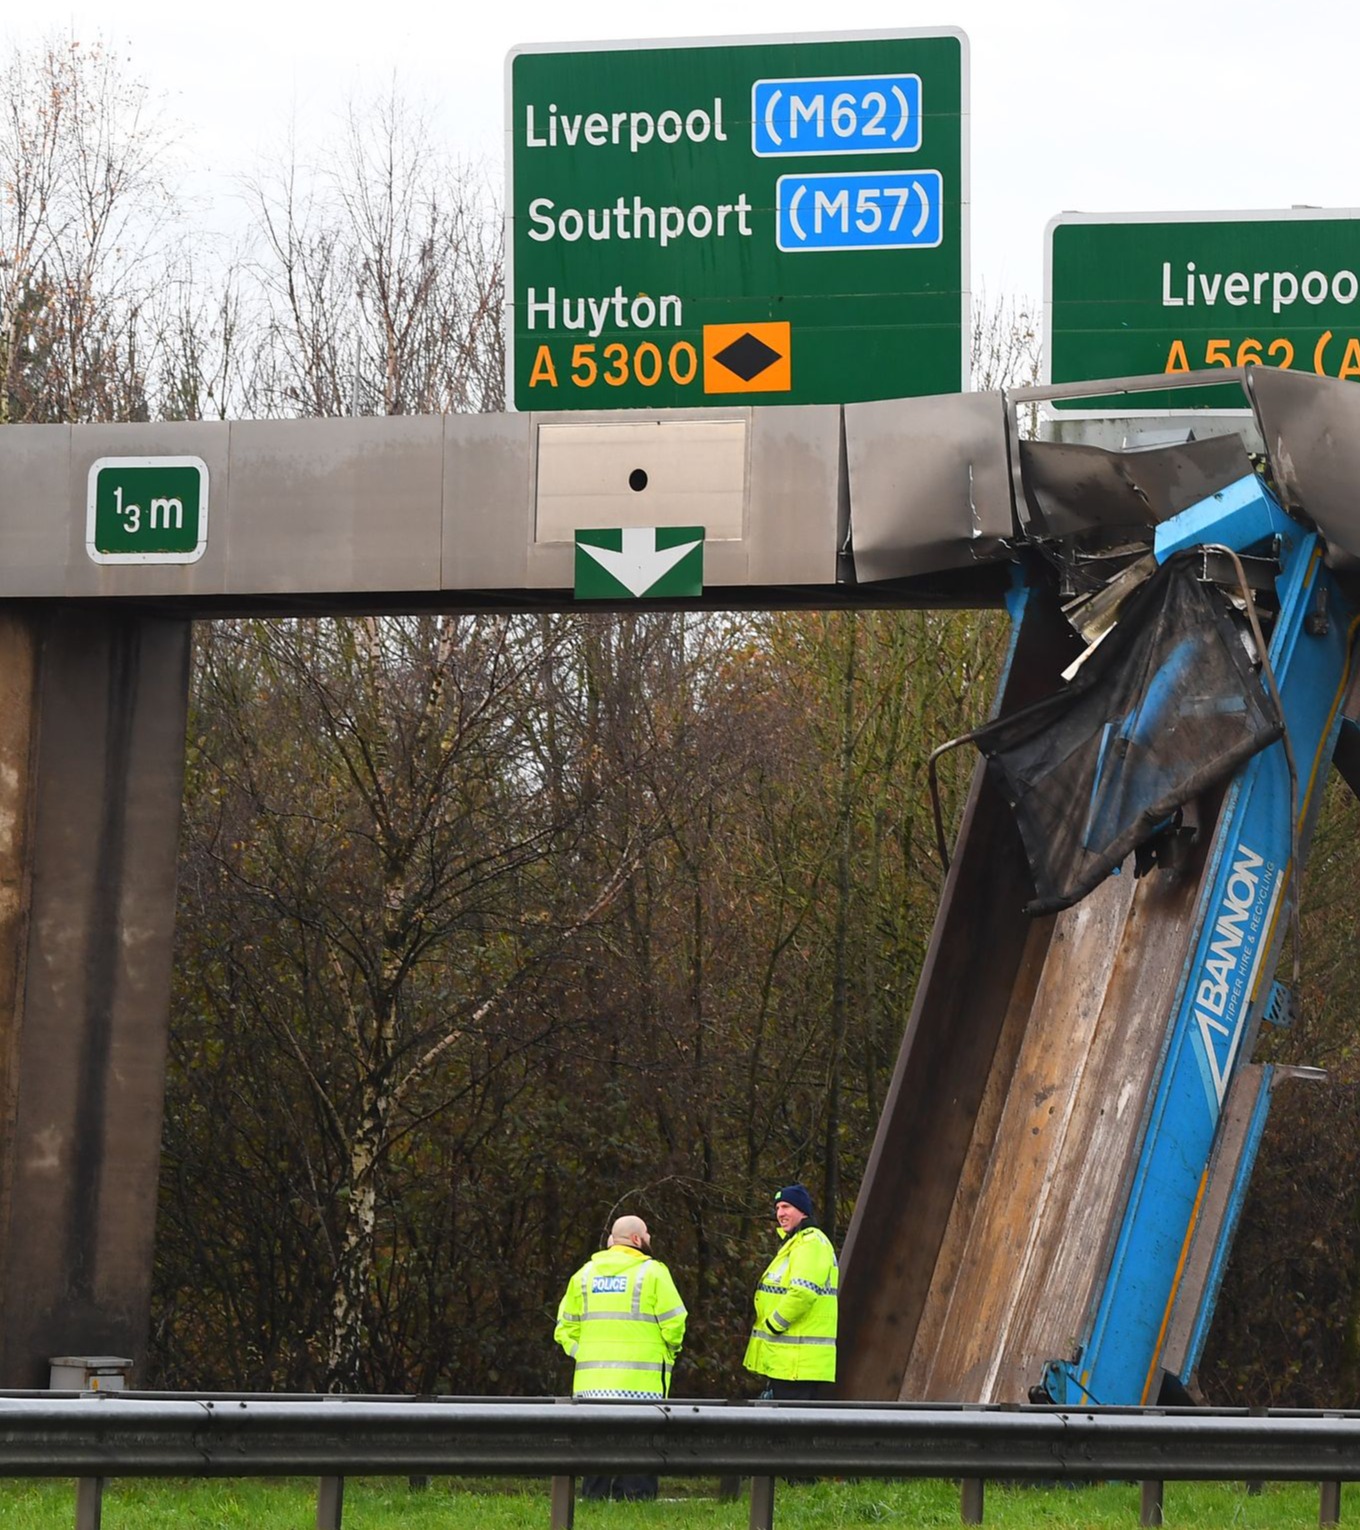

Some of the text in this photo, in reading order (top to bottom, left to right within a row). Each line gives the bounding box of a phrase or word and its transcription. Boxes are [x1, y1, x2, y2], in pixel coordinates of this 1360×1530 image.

[526, 84, 909, 152] Liverpool (M62)
[528, 180, 931, 247] Southport (M57)
[527, 286, 682, 338] Huyton
[150, 498, 183, 529] m
[1196, 844, 1264, 1017] BANNON
[1226, 860, 1275, 1022] TIPPER HIRE & RECYCLING
[592, 1276, 627, 1291] POLICE
